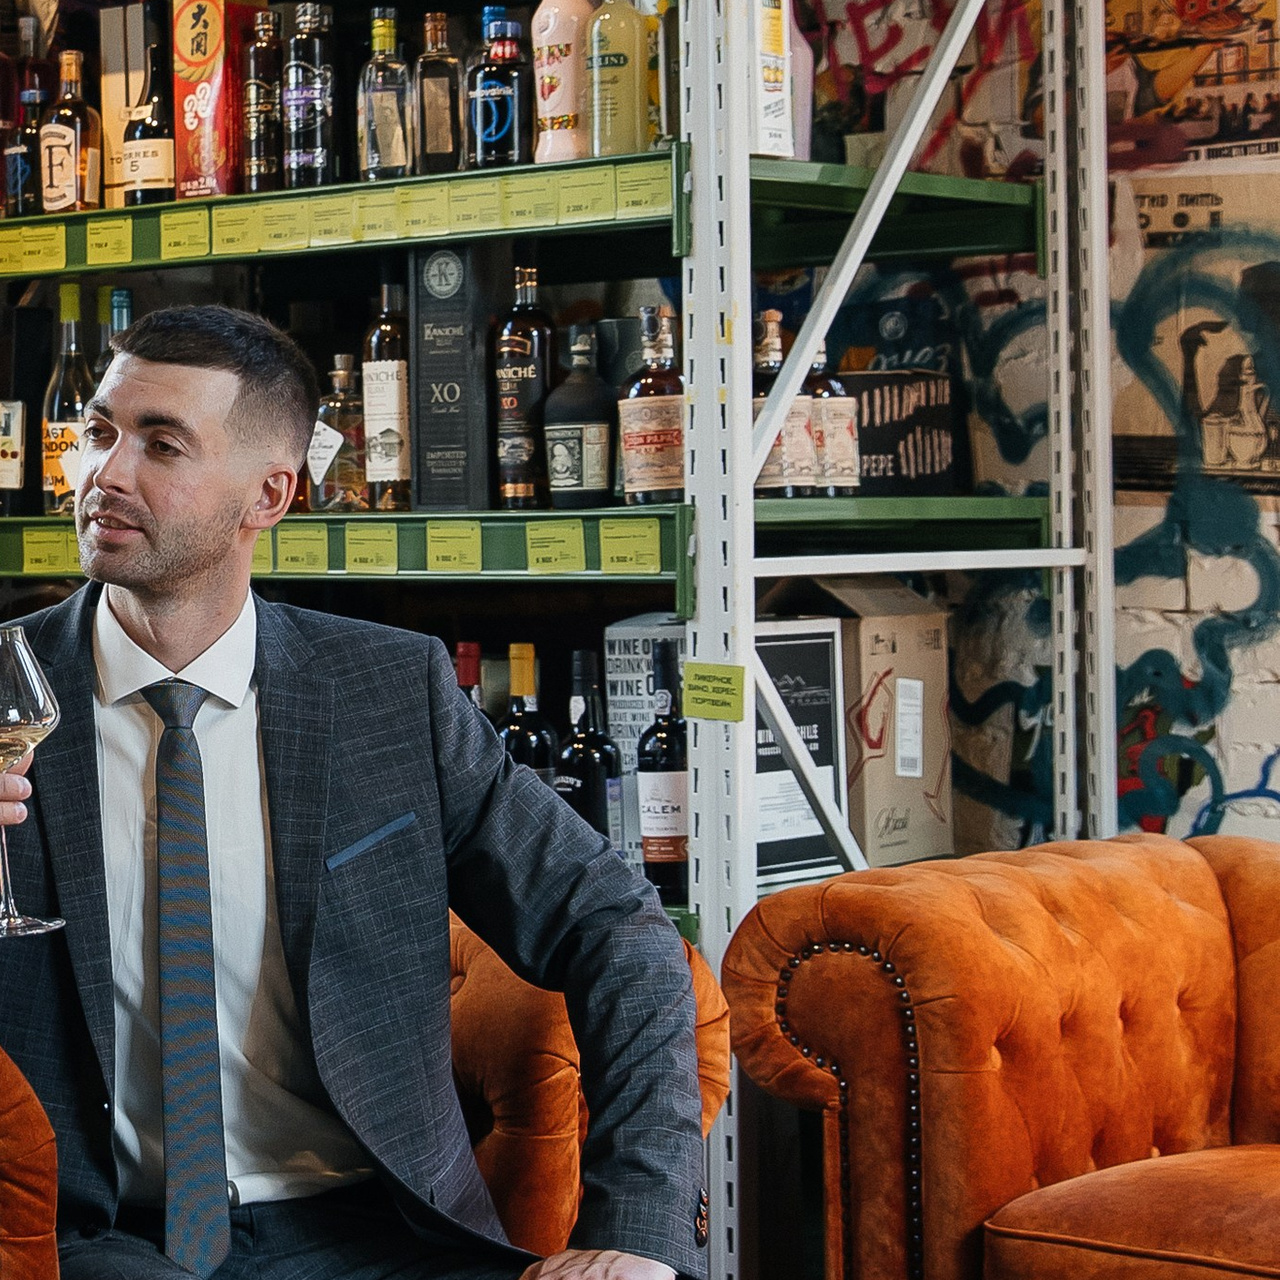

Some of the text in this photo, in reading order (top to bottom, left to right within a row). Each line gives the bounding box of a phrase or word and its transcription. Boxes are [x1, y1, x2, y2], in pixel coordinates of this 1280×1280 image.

[45, 142, 73, 189] F
[129, 160, 140, 172] 5
[430, 382, 461, 403] XO
[861, 454, 895, 477] PEPE
[607, 638, 640, 656] WINE
[607, 658, 646, 674] DRINK
[608, 679, 643, 697] WINE
[693, 673, 733, 685] ЛИКЕРНОЕ
[690, 696, 732, 708] ПОРТВЕЙН
